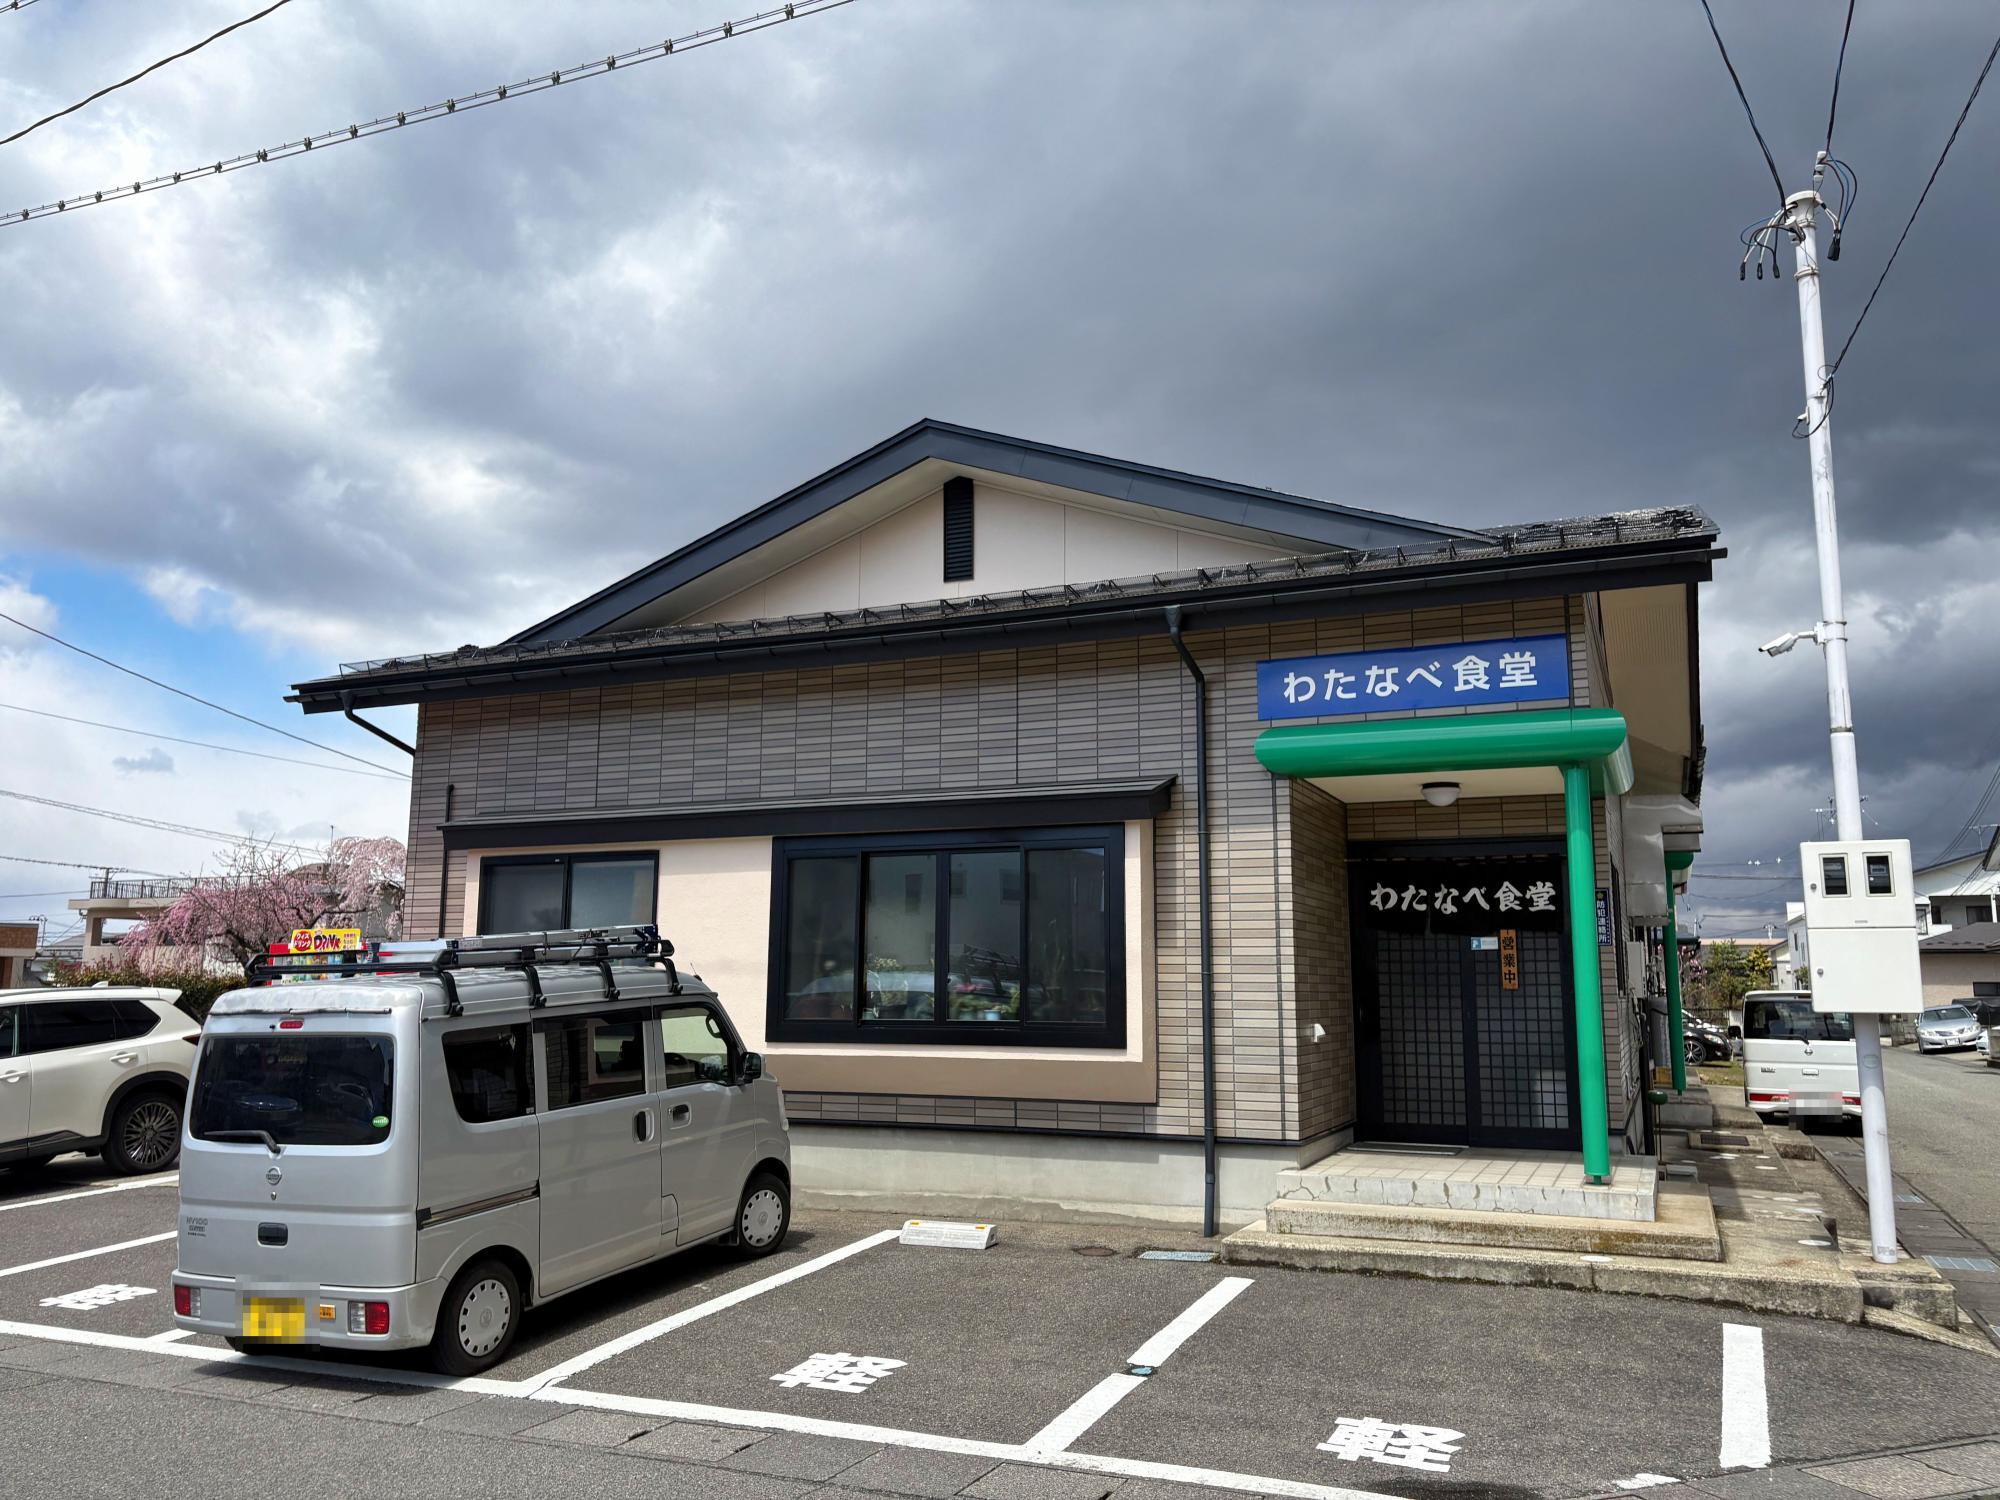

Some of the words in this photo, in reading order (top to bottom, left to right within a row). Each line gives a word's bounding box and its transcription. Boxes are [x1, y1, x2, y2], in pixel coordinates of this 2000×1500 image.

[1283, 651, 1538, 704] わたなべ食堂
[1369, 881, 1556, 915] わたなべ食堂
[1502, 936, 1516, 984] 営業中
[769, 1352, 908, 1393] 軽
[1315, 1416, 1466, 1473] 軽
